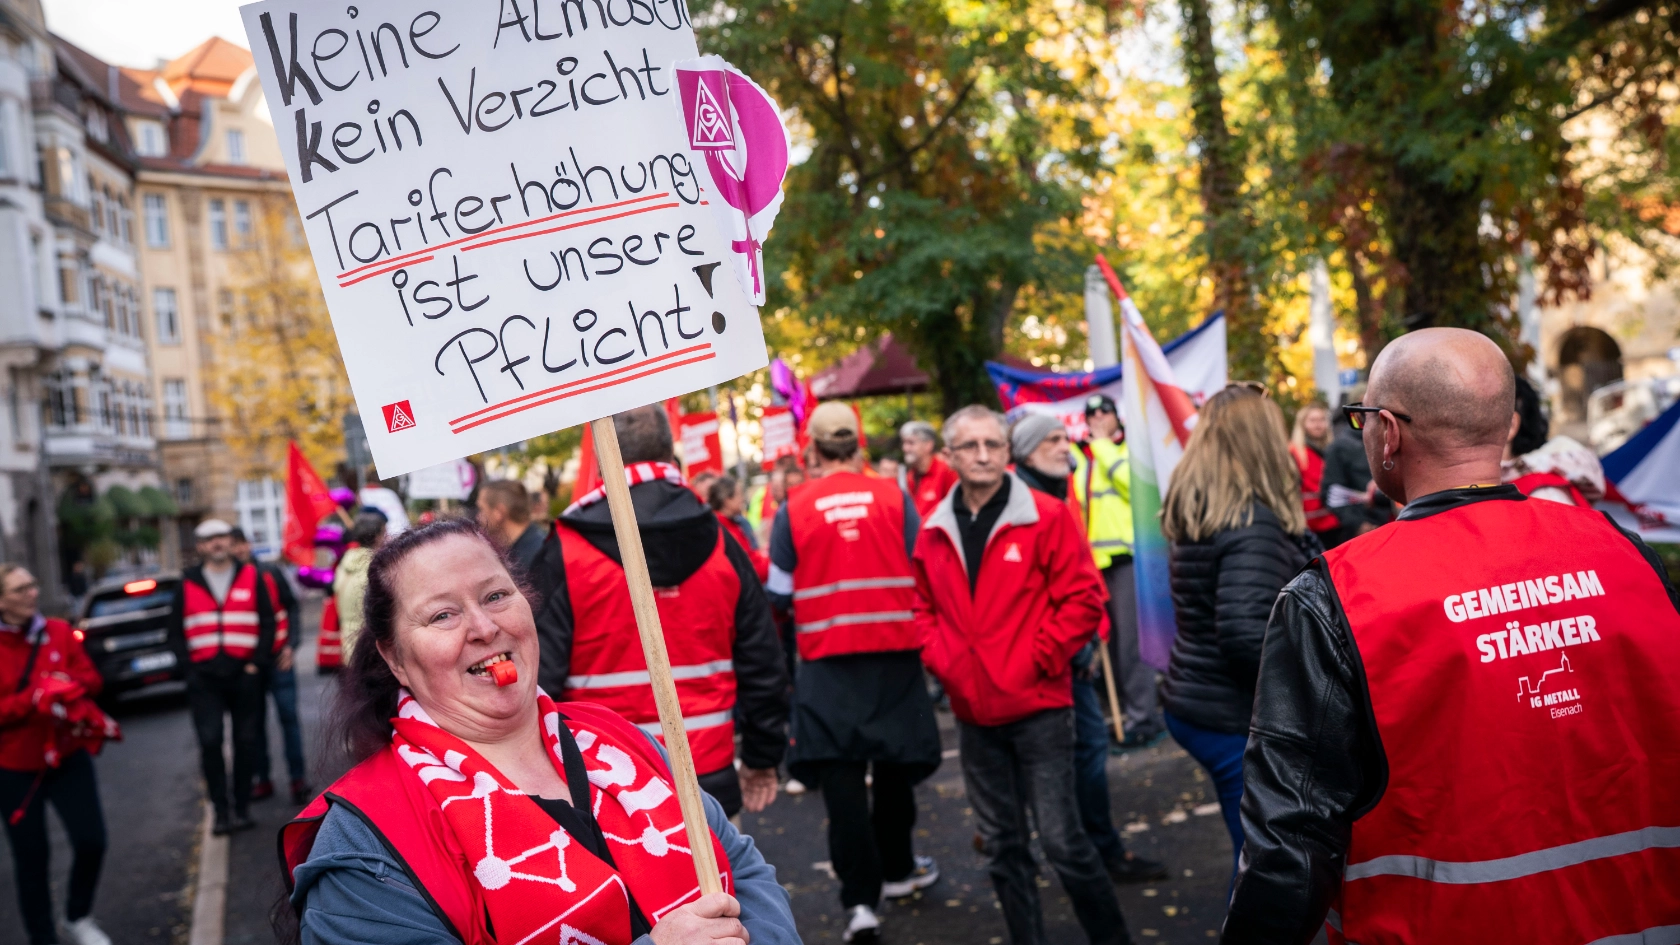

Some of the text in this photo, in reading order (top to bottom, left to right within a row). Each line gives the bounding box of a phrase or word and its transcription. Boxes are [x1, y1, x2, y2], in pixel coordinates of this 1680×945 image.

[260, 6, 461, 107] Keine
[295, 48, 669, 184] kein Verzicht
[306, 147, 700, 270] Tariferhöhung
[392, 224, 705, 326] ist unsere
[1443, 570, 1605, 623] GEMEINSAM
[1476, 614, 1601, 663] STÄRKER
[1529, 688, 1581, 709] IG METALL
[1550, 703, 1583, 719] Eisenach
